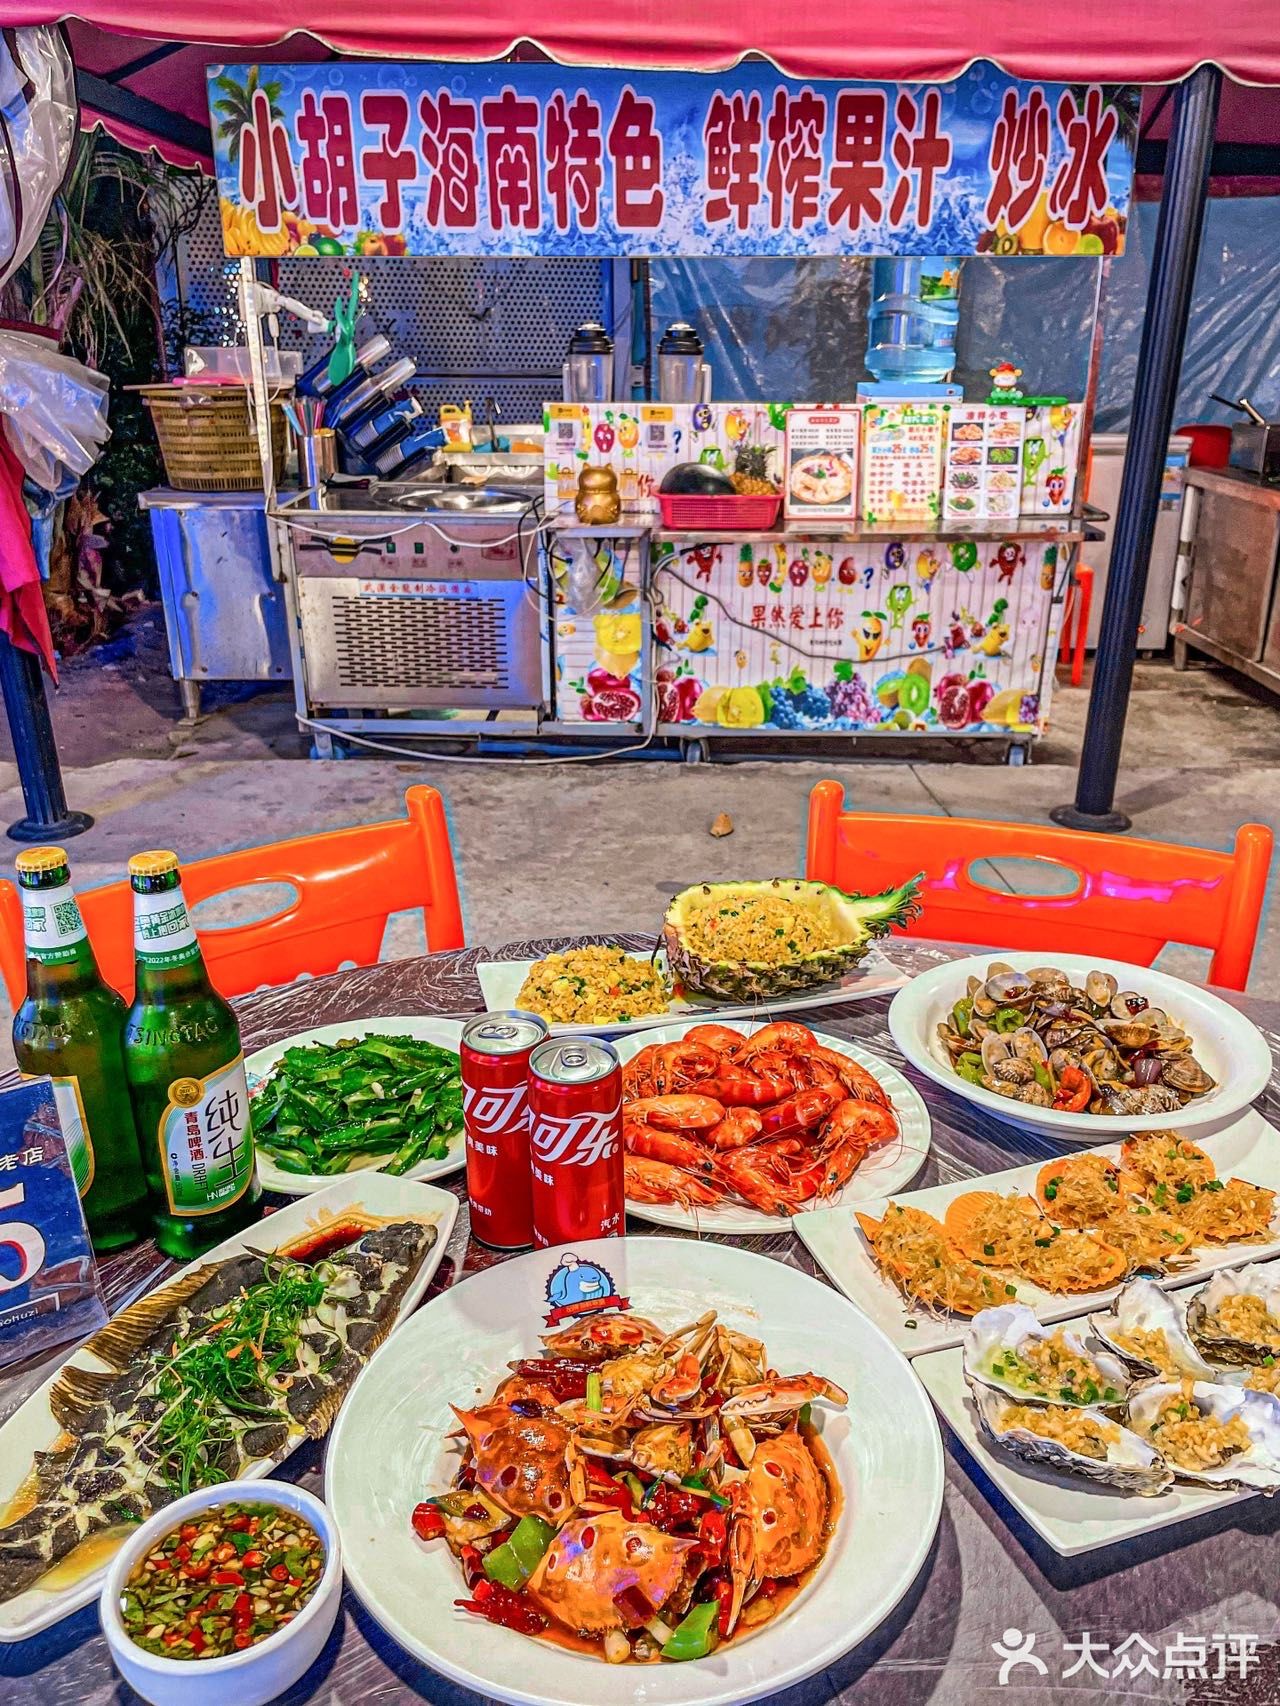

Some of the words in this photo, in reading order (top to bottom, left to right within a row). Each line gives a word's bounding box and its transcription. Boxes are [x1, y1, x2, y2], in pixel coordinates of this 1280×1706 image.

[239, 85, 664, 234] 小胡子海南特色
[705, 86, 951, 232] 鲜榨果汁
[985, 85, 1117, 232] 炒冰
[751, 604, 844, 630] 果然爱上你
[205, 1090, 249, 1188] 纯生
[600, 1212, 620, 1232] 汽水
